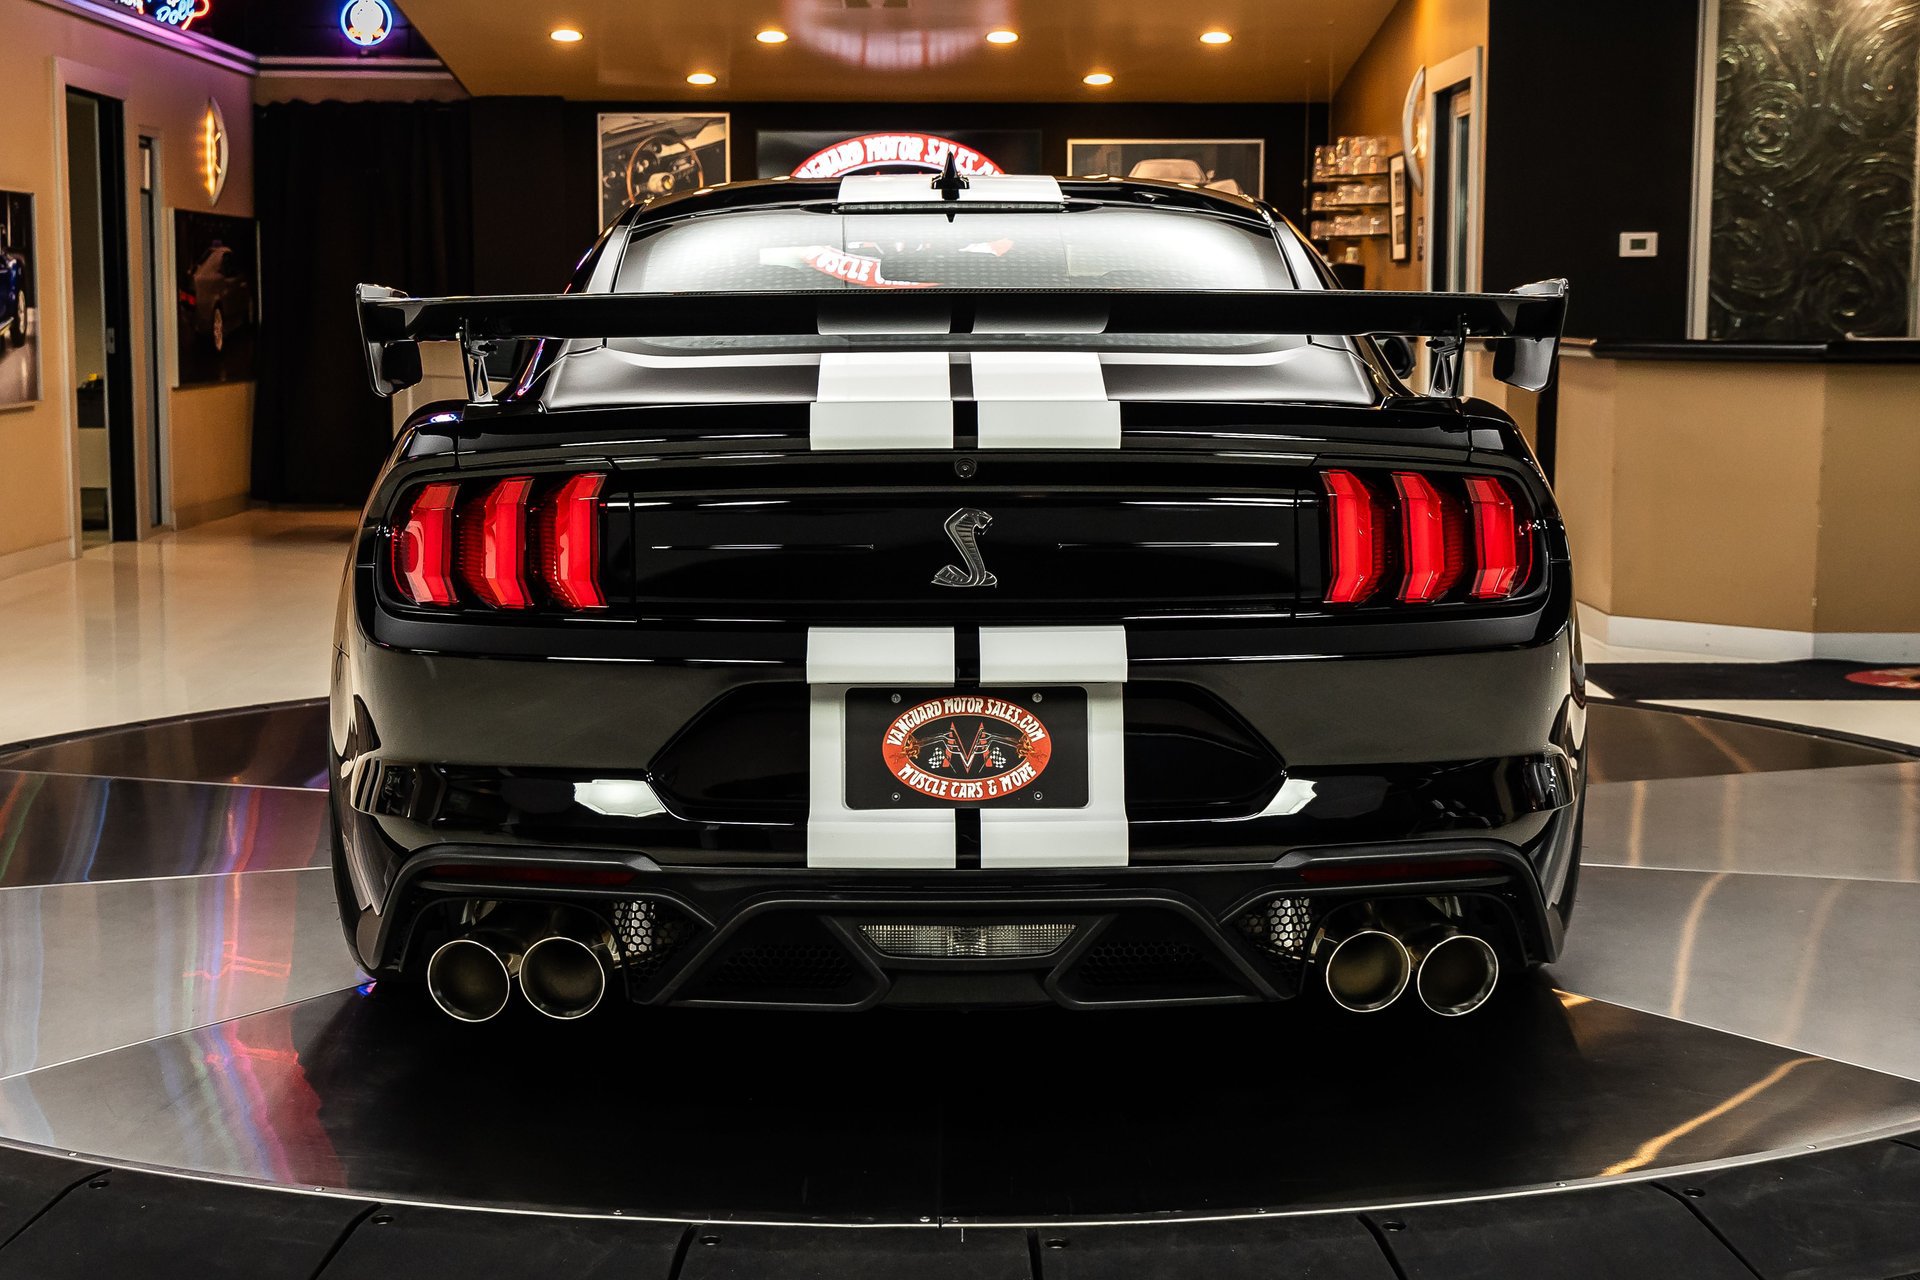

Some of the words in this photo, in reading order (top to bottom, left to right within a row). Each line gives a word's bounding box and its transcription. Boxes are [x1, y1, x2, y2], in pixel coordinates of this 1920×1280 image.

[795, 140, 865, 178] GUARD
[864, 136, 924, 163] MOTOR
[886, 701, 942, 746] VANGUARD
[943, 697, 984, 714] MOTOR
[985, 698, 1046, 743] SALES.COM
[897, 763, 949, 797] MUSCLE
[950, 781, 984, 799] CARS
[988, 780, 998, 796] &
[999, 761, 1037, 792] MORE
